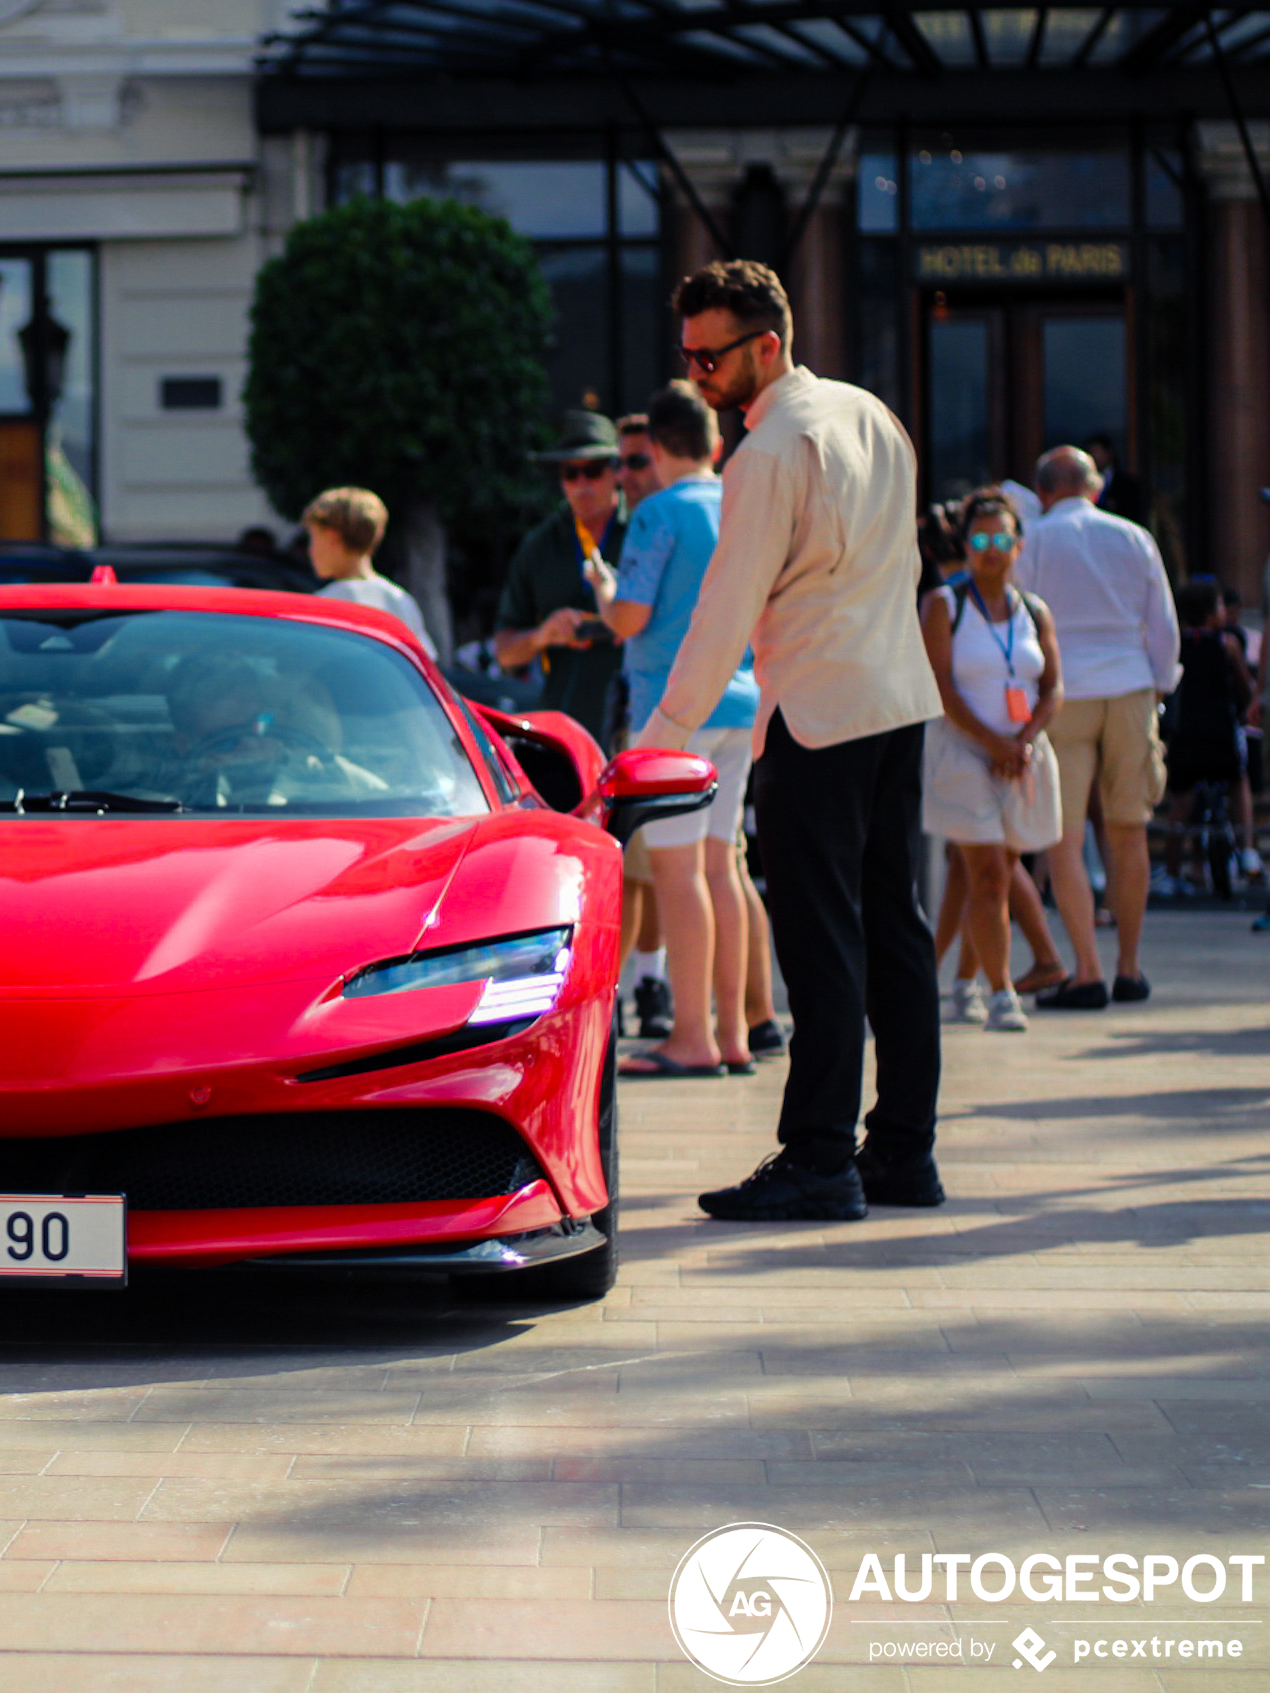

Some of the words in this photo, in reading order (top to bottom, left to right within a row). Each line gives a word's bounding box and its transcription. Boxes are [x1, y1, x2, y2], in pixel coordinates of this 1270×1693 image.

[921, 247, 1004, 275] HOTEL
[1047, 245, 1122, 274] PARIS
[6, 1211, 70, 1262] 90
